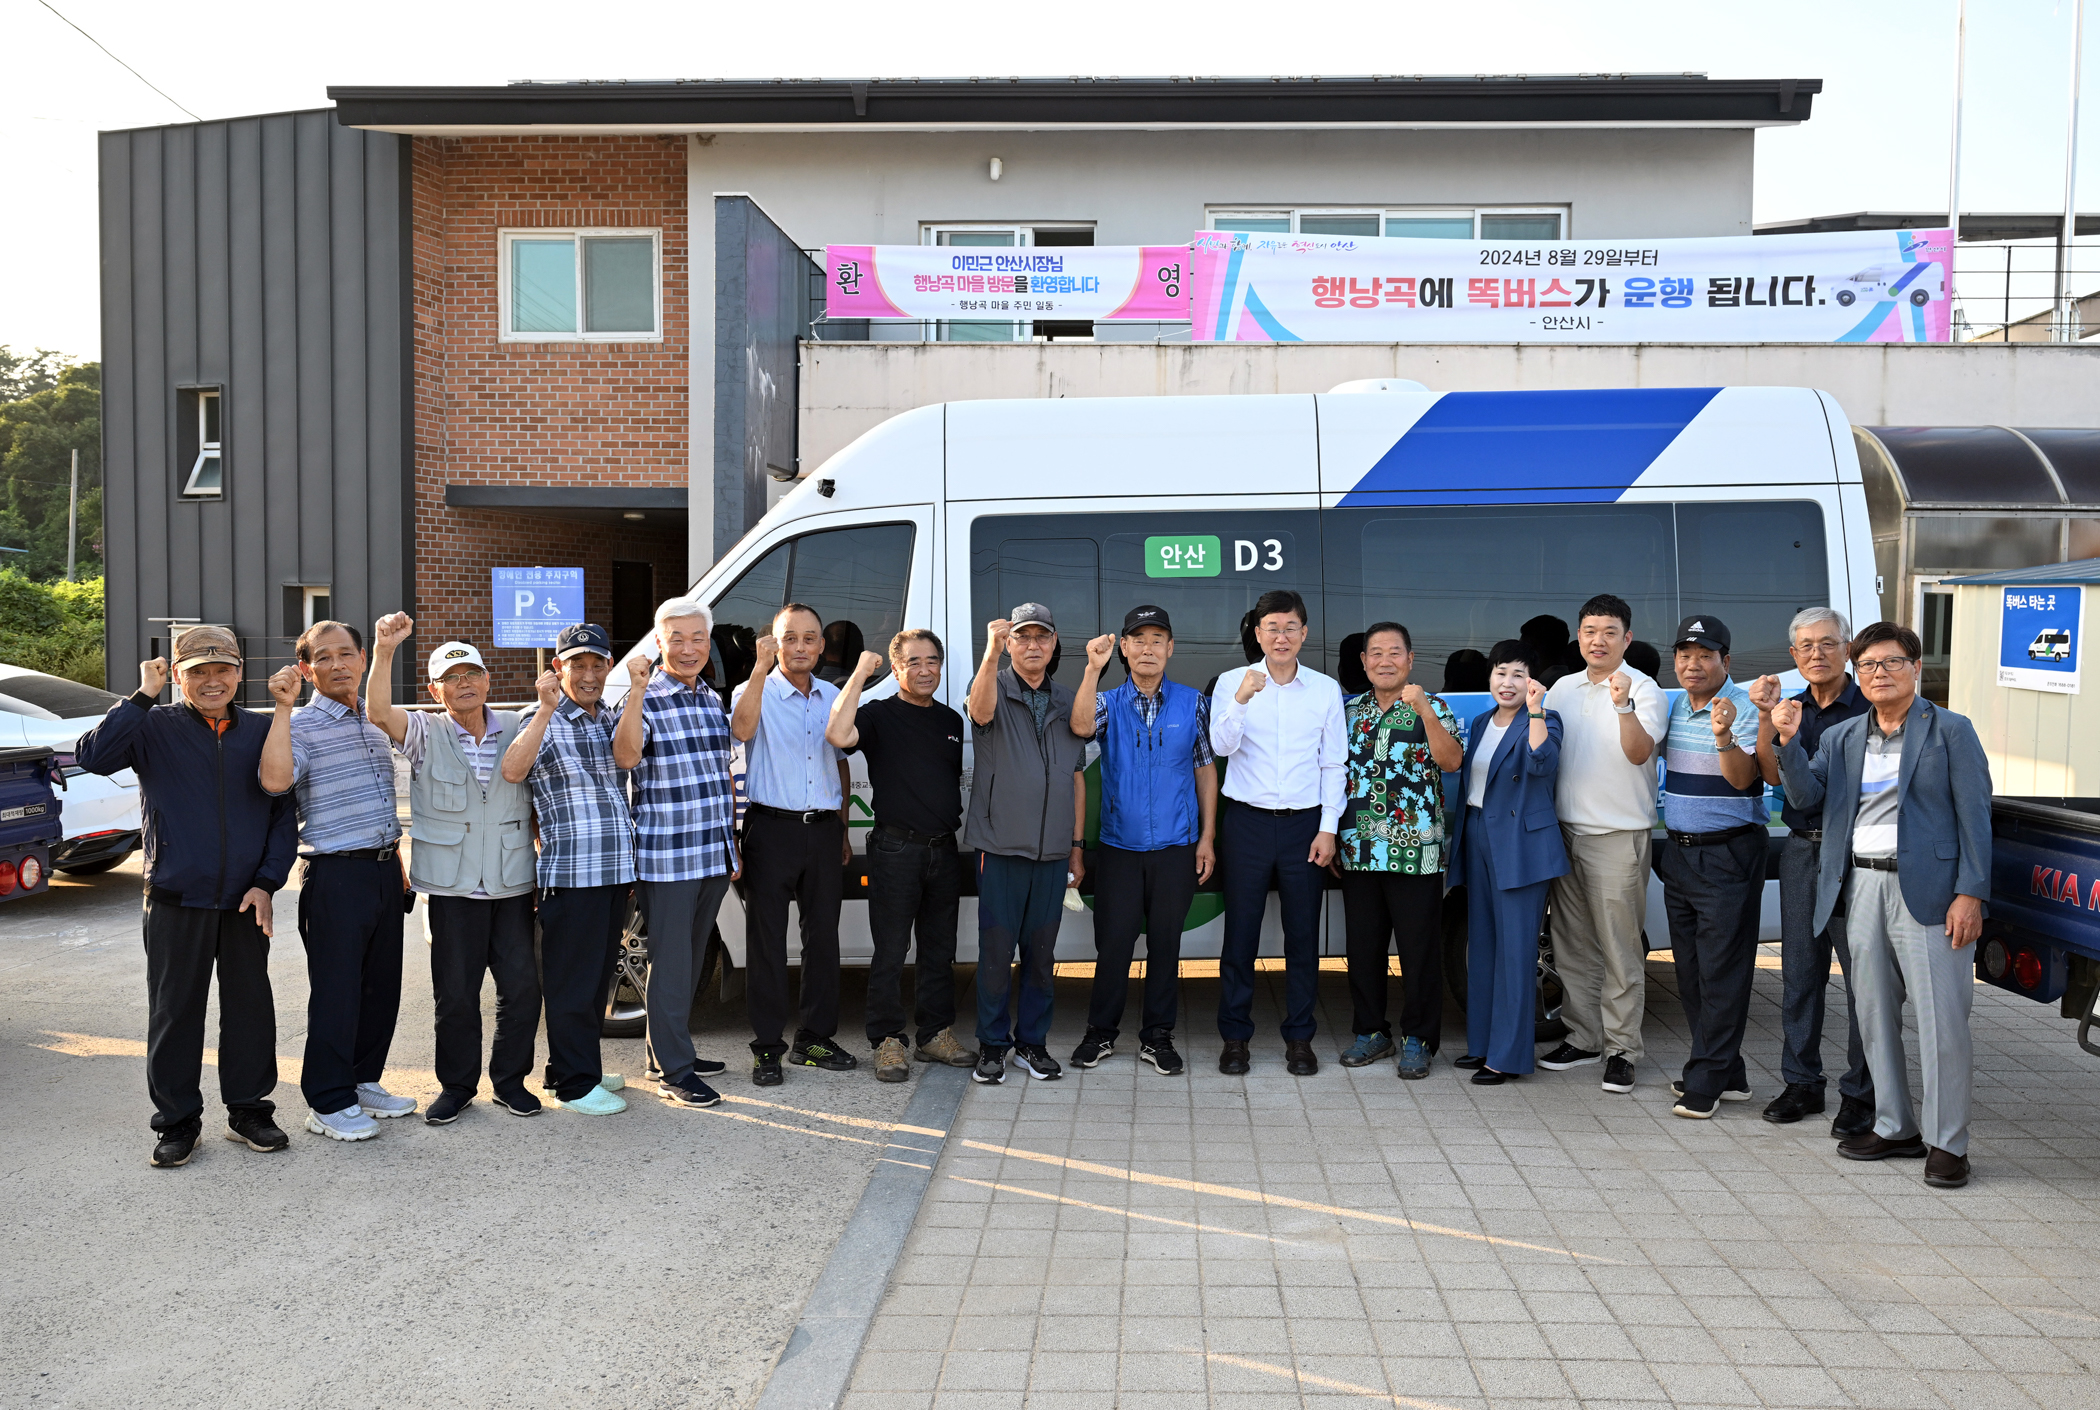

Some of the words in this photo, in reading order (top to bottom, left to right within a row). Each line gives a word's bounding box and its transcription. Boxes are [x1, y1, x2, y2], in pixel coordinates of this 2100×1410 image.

[1330, 240, 1358, 252] 안산
[952, 255, 993, 271] 이민근
[996, 255, 1063, 272] 안산시장님
[1480, 249, 1541, 266] 2024년
[1548, 249, 1577, 267] 8월
[1583, 249, 1659, 267] 29일부터
[836, 261, 862, 295] 환
[913, 275, 955, 293] 행낭곡
[957, 275, 985, 293] 마을
[987, 275, 1028, 293] 방문을
[1030, 276, 1099, 293] 환영합니다
[1158, 263, 1181, 297] 영
[1312, 276, 1453, 309] 행낭곡에
[1467, 277, 1610, 309] 똑버스가
[1623, 276, 1694, 309] 운행
[1707, 275, 1826, 307] 됩니다.
[959, 300, 987, 310] 행낭곡
[991, 300, 1010, 310] 마을
[1014, 300, 1032, 311] 주민
[1036, 300, 1054, 311] 일동
[1542, 316, 1591, 330] 안산시
[1160, 543, 1206, 569] 안산
[1234, 538, 1284, 572] D3
[515, 590, 535, 616] P
[2006, 594, 2027, 610] 똑버스
[2029, 595, 2046, 611] 타는
[2047, 595, 2056, 611] 곳
[26, 806, 44, 814] 1000kg
[2031, 864, 2080, 907] KIA
